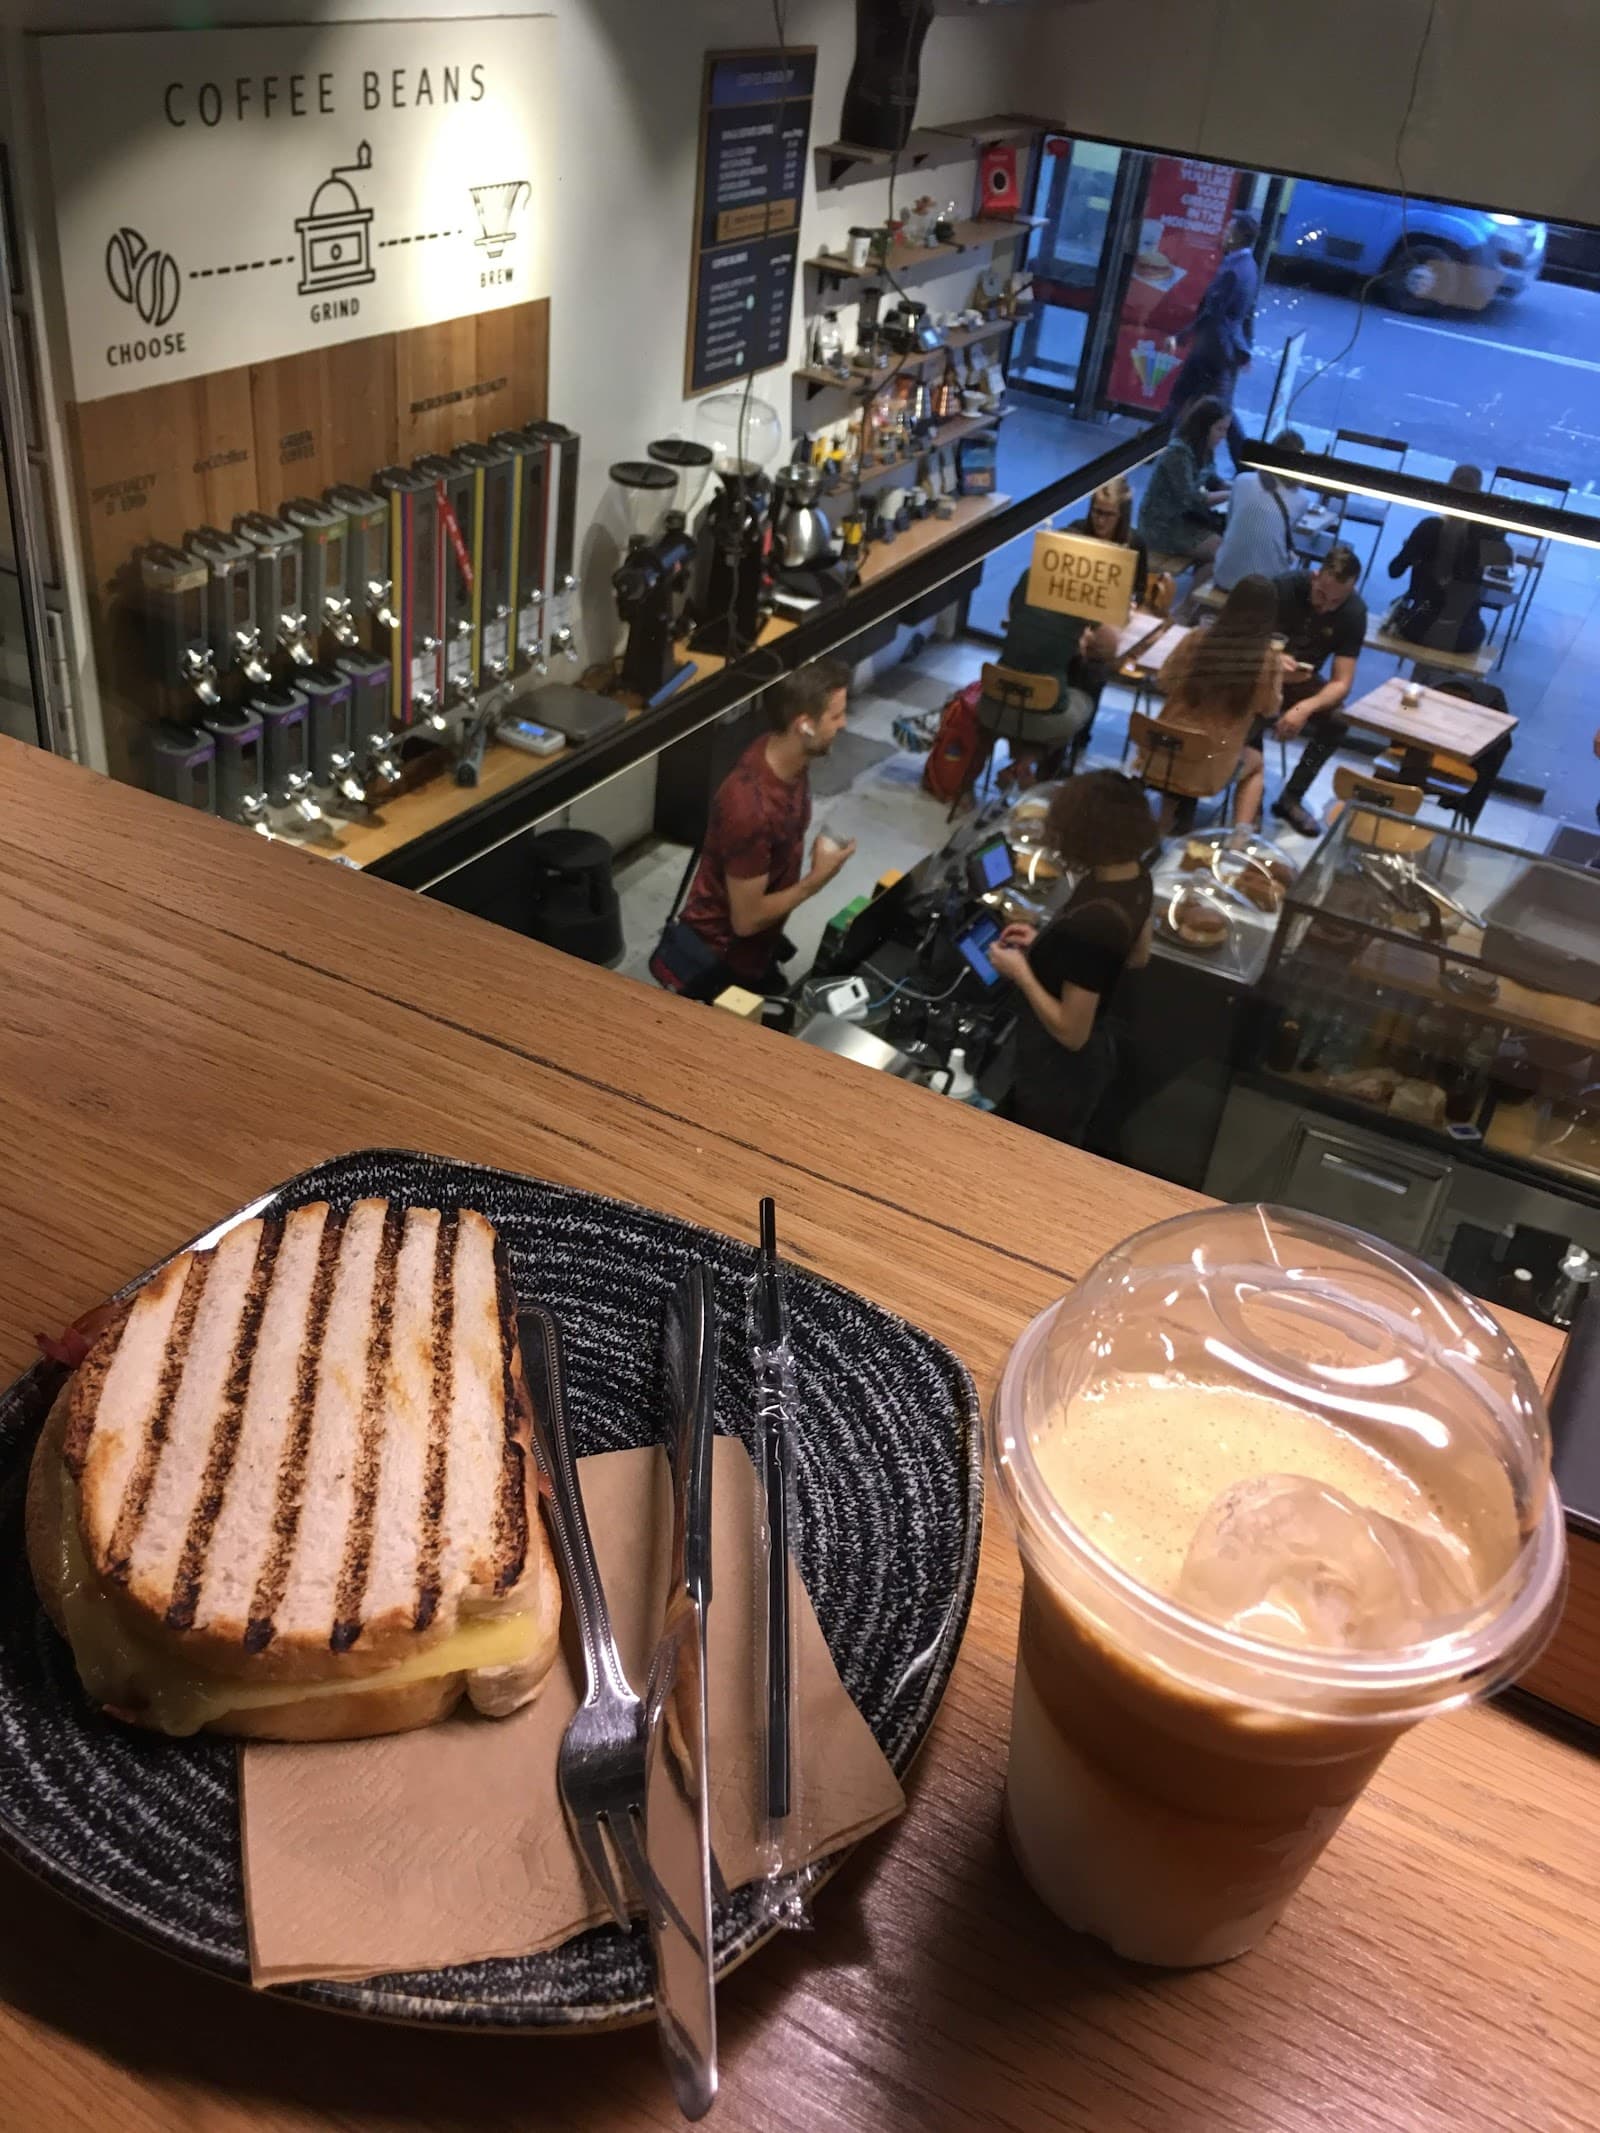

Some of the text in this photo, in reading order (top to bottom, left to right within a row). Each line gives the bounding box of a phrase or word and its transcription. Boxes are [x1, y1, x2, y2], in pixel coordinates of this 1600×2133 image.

[164, 64, 486, 127] COFFEE BEANS
[481, 268, 515, 288] BREW
[310, 298, 360, 324] GRIND
[107, 332, 187, 367] CHOOSE
[1042, 549, 1122, 588] ORDER
[1048, 576, 1109, 610] HERE
